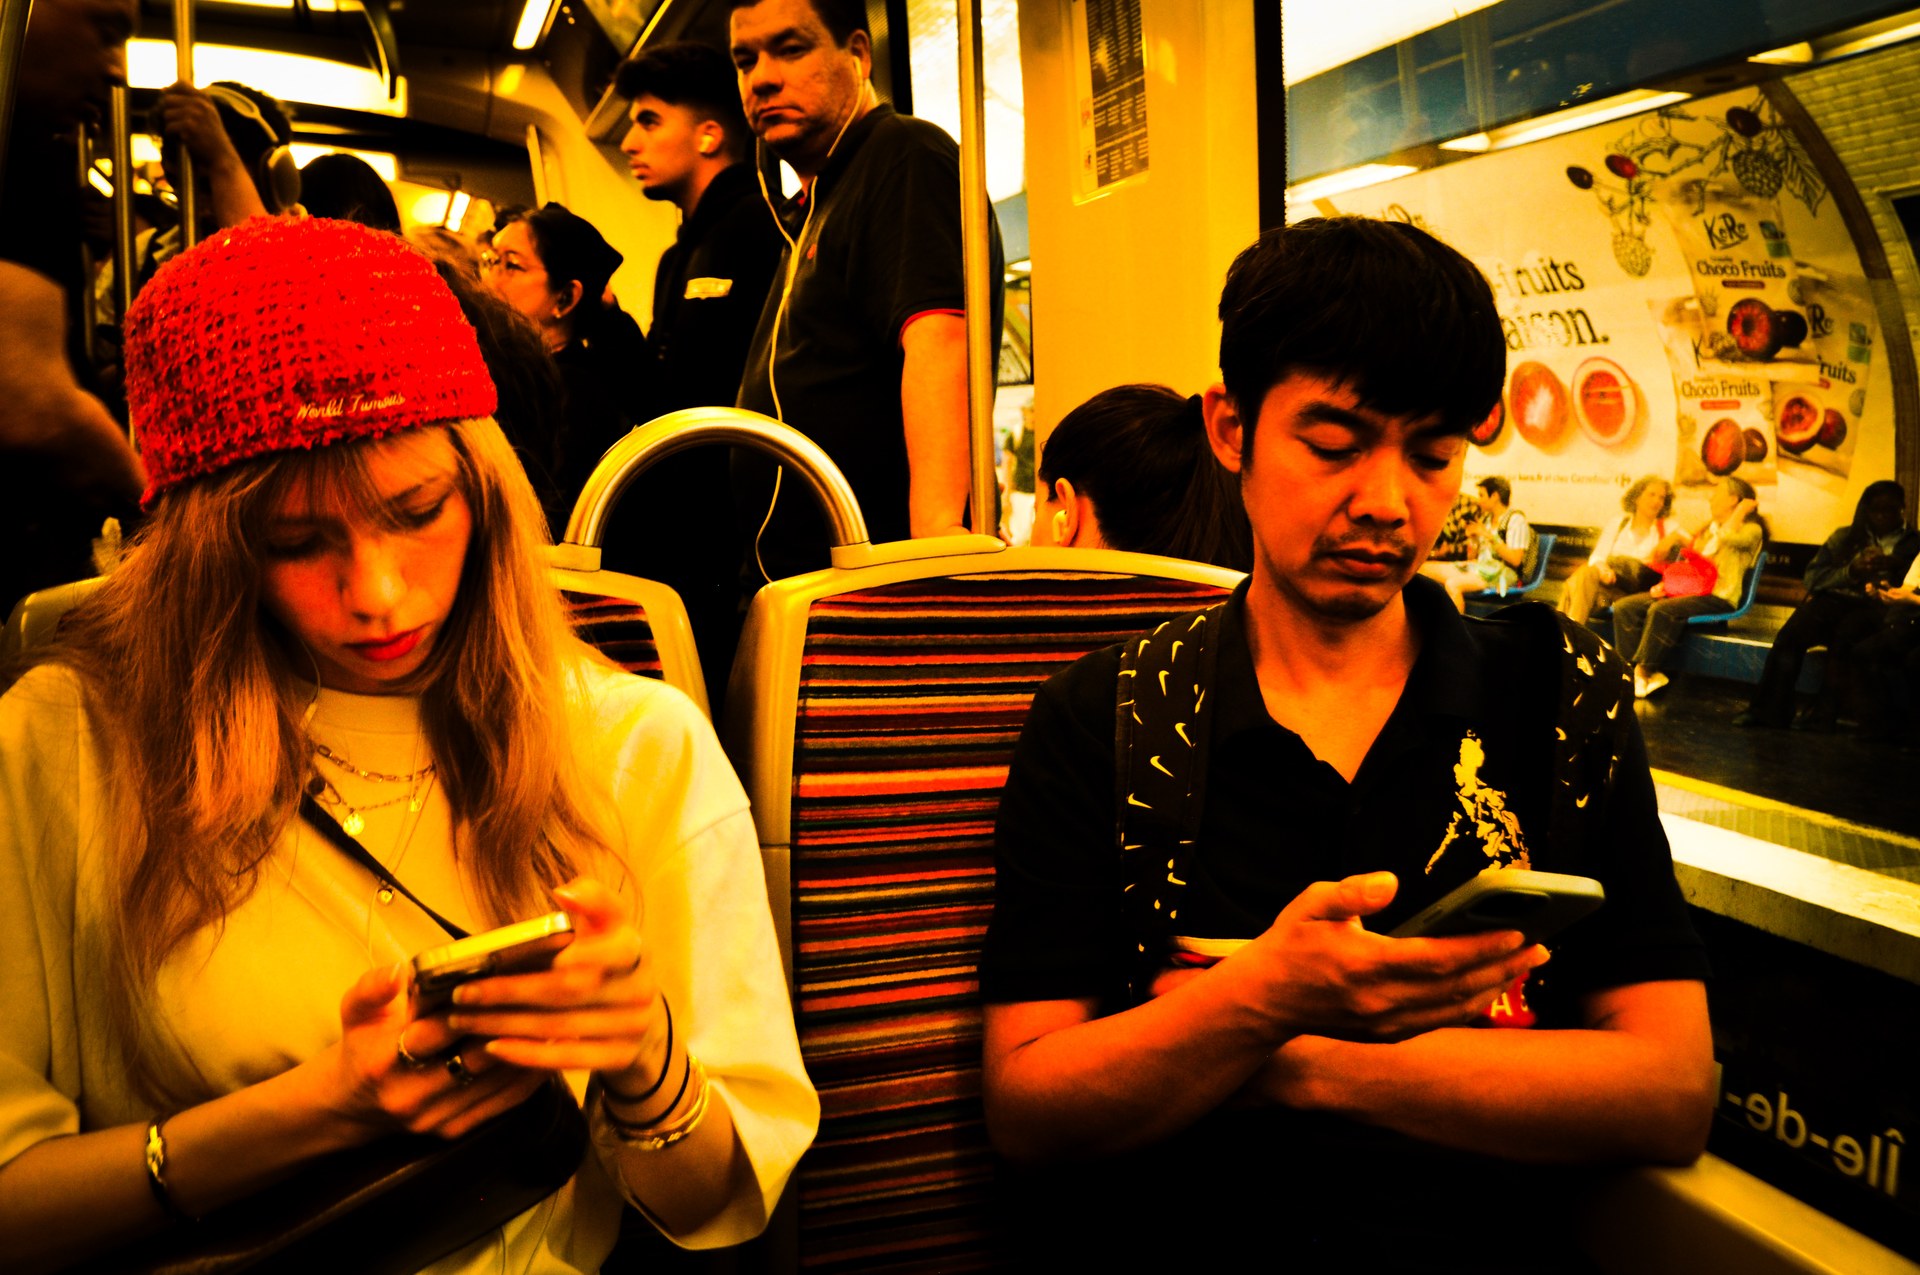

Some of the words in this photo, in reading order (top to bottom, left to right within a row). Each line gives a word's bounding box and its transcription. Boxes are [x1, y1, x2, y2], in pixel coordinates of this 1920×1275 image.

[1697, 260, 1740, 277] Choco
[1740, 260, 1786, 279] Fruits
[1817, 355, 1856, 385] ruits
[1681, 381, 1719, 399] Choco
[1720, 379, 1760, 397] Fruits
[296, 398, 343, 420] World
